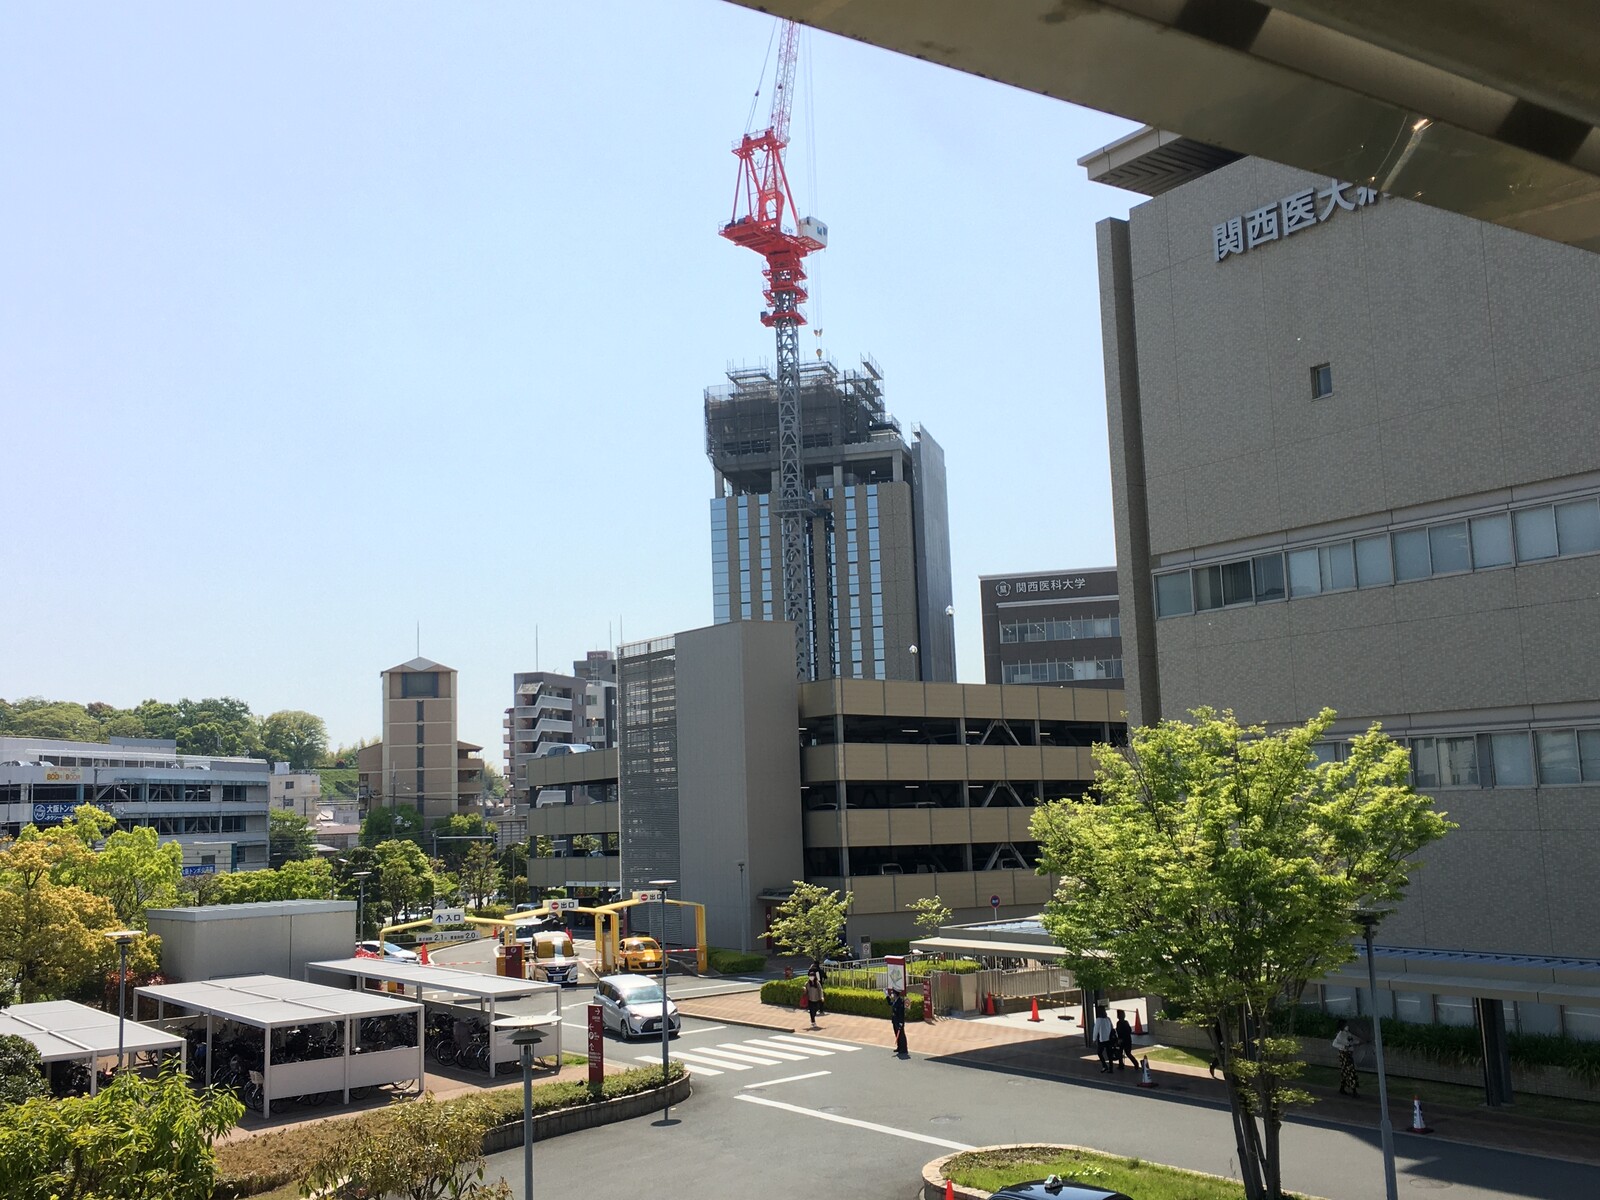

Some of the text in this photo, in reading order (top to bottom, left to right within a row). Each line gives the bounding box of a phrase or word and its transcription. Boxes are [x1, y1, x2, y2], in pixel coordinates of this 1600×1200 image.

[1016, 578, 1086, 593] 関西医科大学
